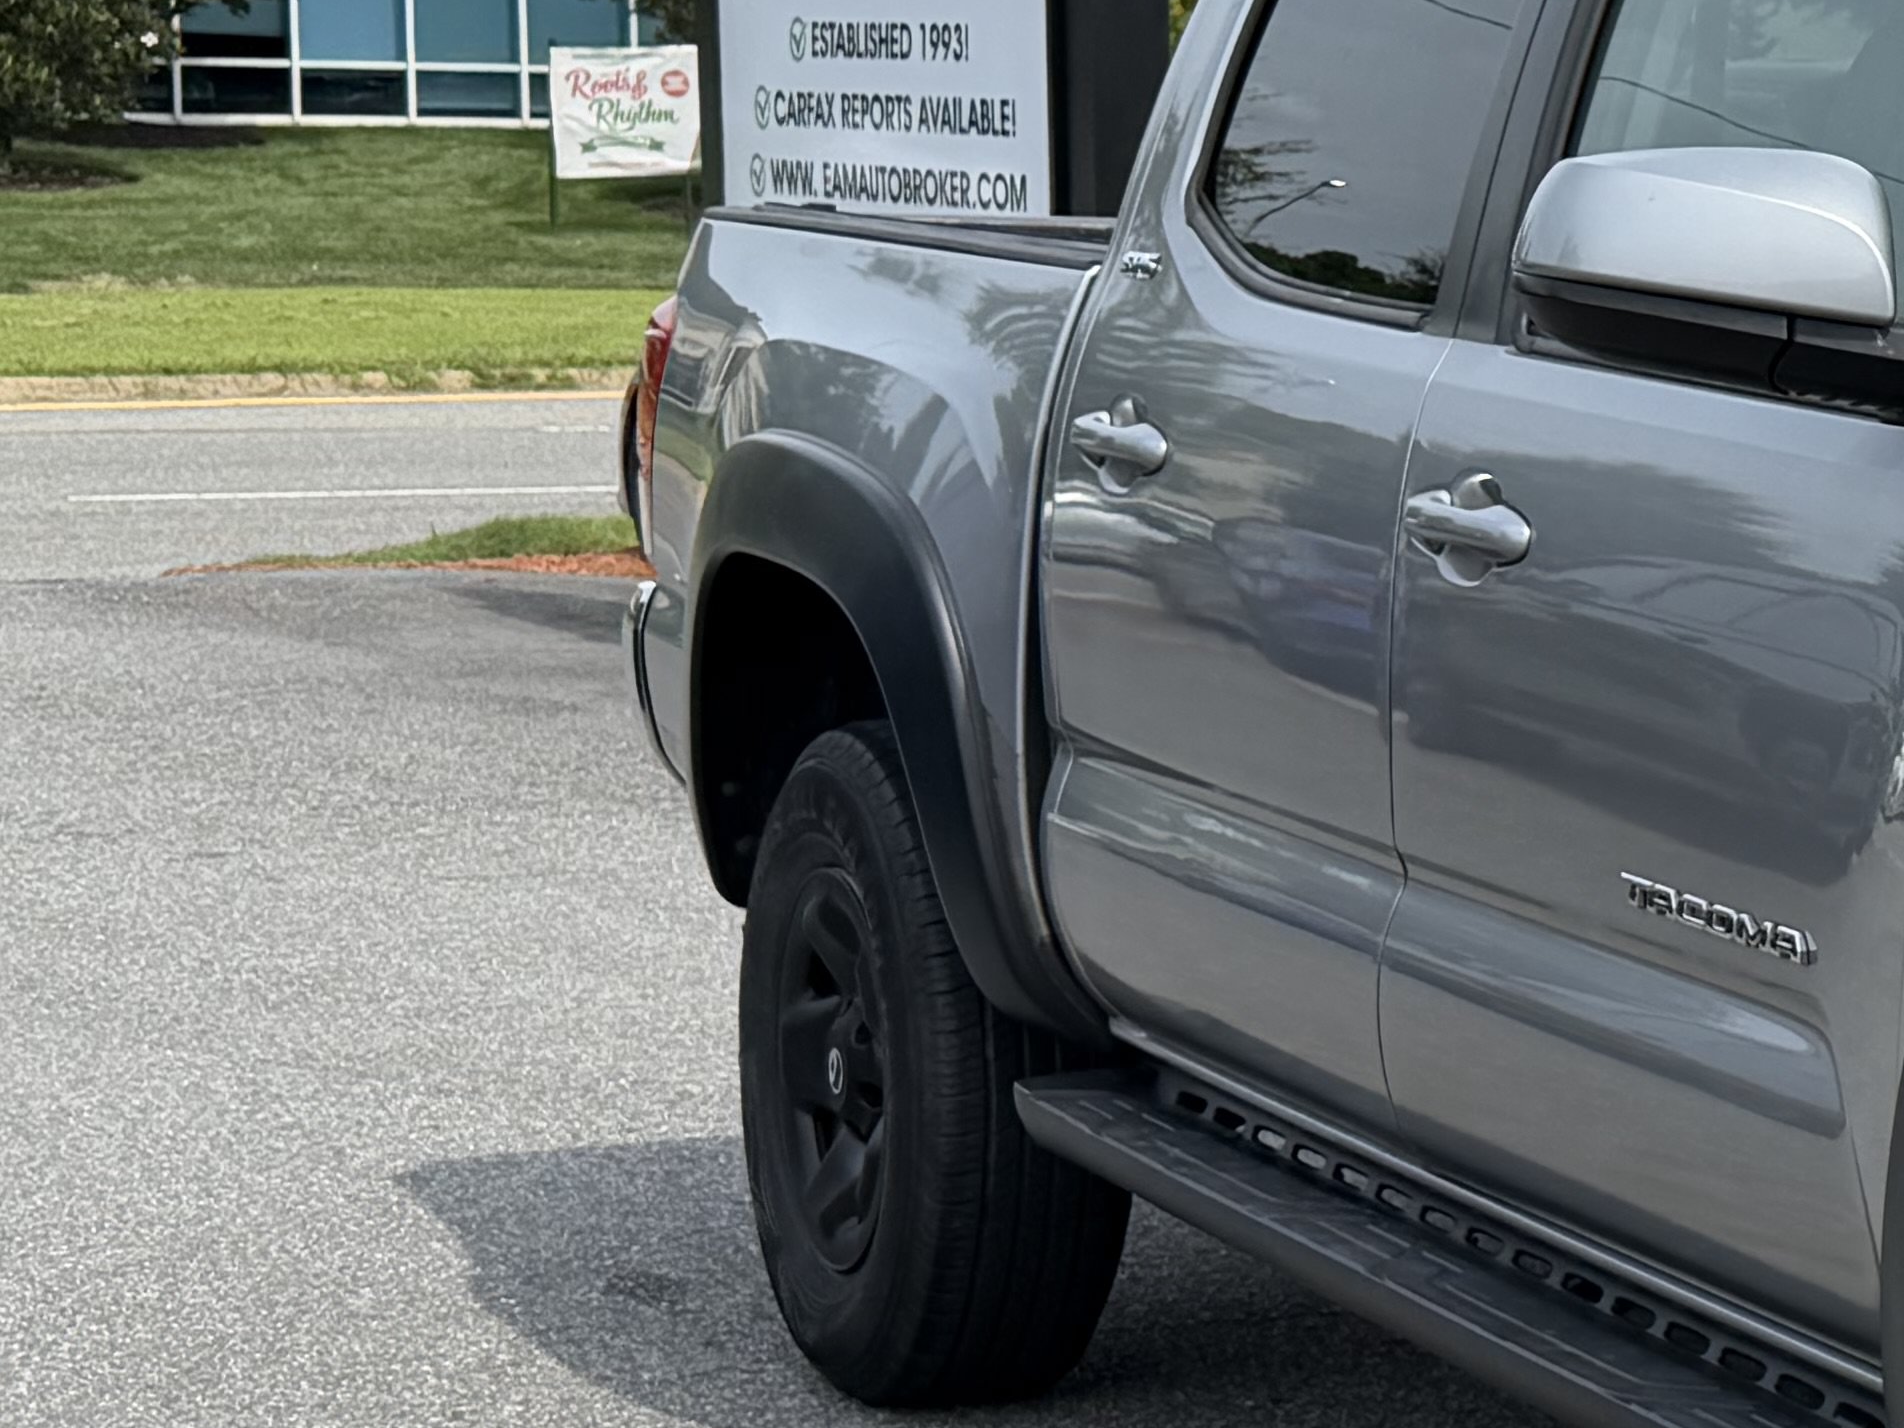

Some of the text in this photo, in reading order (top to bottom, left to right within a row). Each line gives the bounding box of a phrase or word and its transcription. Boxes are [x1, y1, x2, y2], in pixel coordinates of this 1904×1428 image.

[811, 20, 969, 63] ESTABLISHED 1993!
[588, 97, 681, 132] Rhythm
[774, 89, 1017, 138] CARFAX REPORTS AVAILABLE!
[1620, 871, 1818, 967] TACOMA
